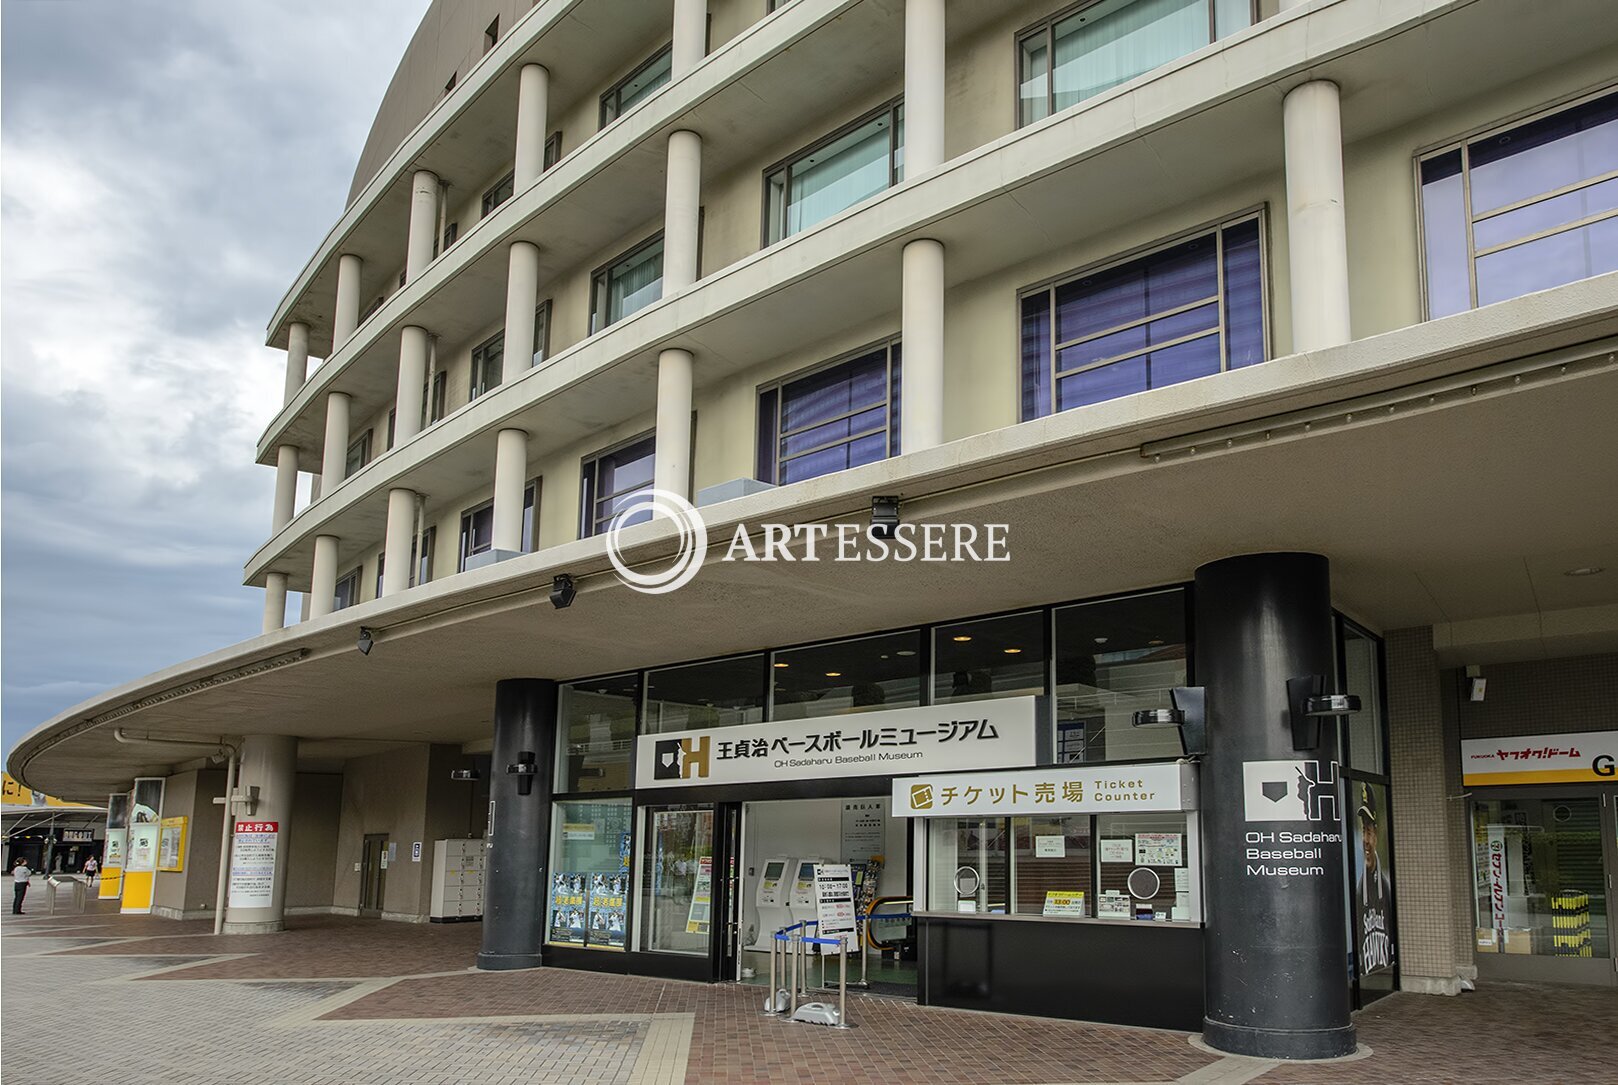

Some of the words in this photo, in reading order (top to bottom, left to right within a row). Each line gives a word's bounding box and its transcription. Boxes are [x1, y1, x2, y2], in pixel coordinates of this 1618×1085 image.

[716, 718, 999, 761] 王貞治ベースボールミュージアム
[774, 760, 788, 768] OH
[789, 758, 833, 767] Sadaharu
[835, 754, 876, 764] Baseball
[878, 751, 923, 761] Museum
[1592, 755, 1615, 776] G
[1095, 779, 1143, 789] Ticket
[940, 781, 1084, 806] チケット売場
[1095, 791, 1155, 801] Counter
[237, 823, 275, 832] 禁止行為
[1245, 832, 1275, 843] OH
[1246, 848, 1322, 860] Baseball
[1247, 864, 1324, 876] Museum
